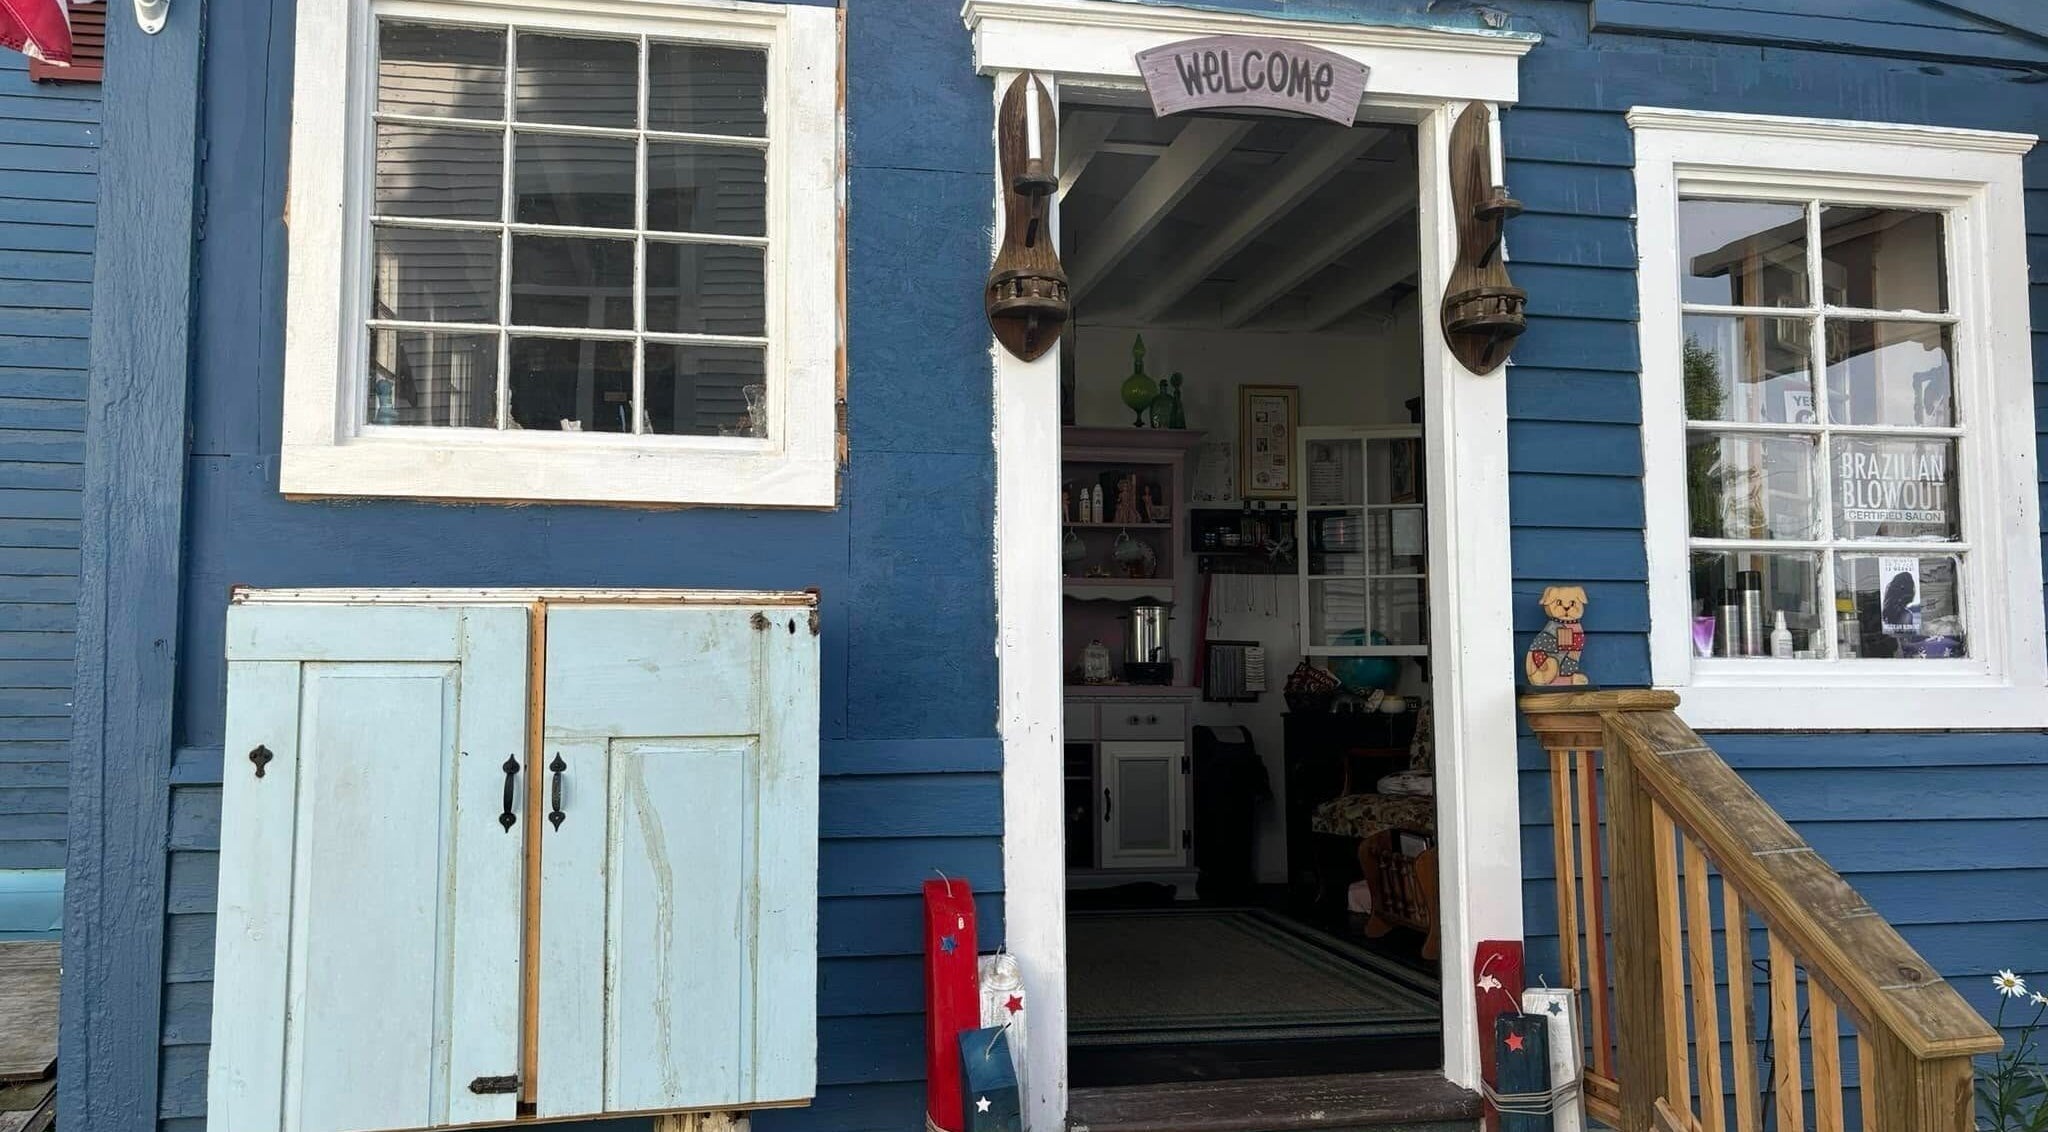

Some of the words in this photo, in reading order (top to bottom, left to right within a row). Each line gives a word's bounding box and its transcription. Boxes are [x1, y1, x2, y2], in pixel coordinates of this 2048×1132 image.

[1842, 452, 1945, 481] BRAZILIAN
[1844, 480, 1945, 510] BLOWOUT
[1849, 510, 1903, 521] CERTIFIED
[1905, 512, 1941, 522] SALON
